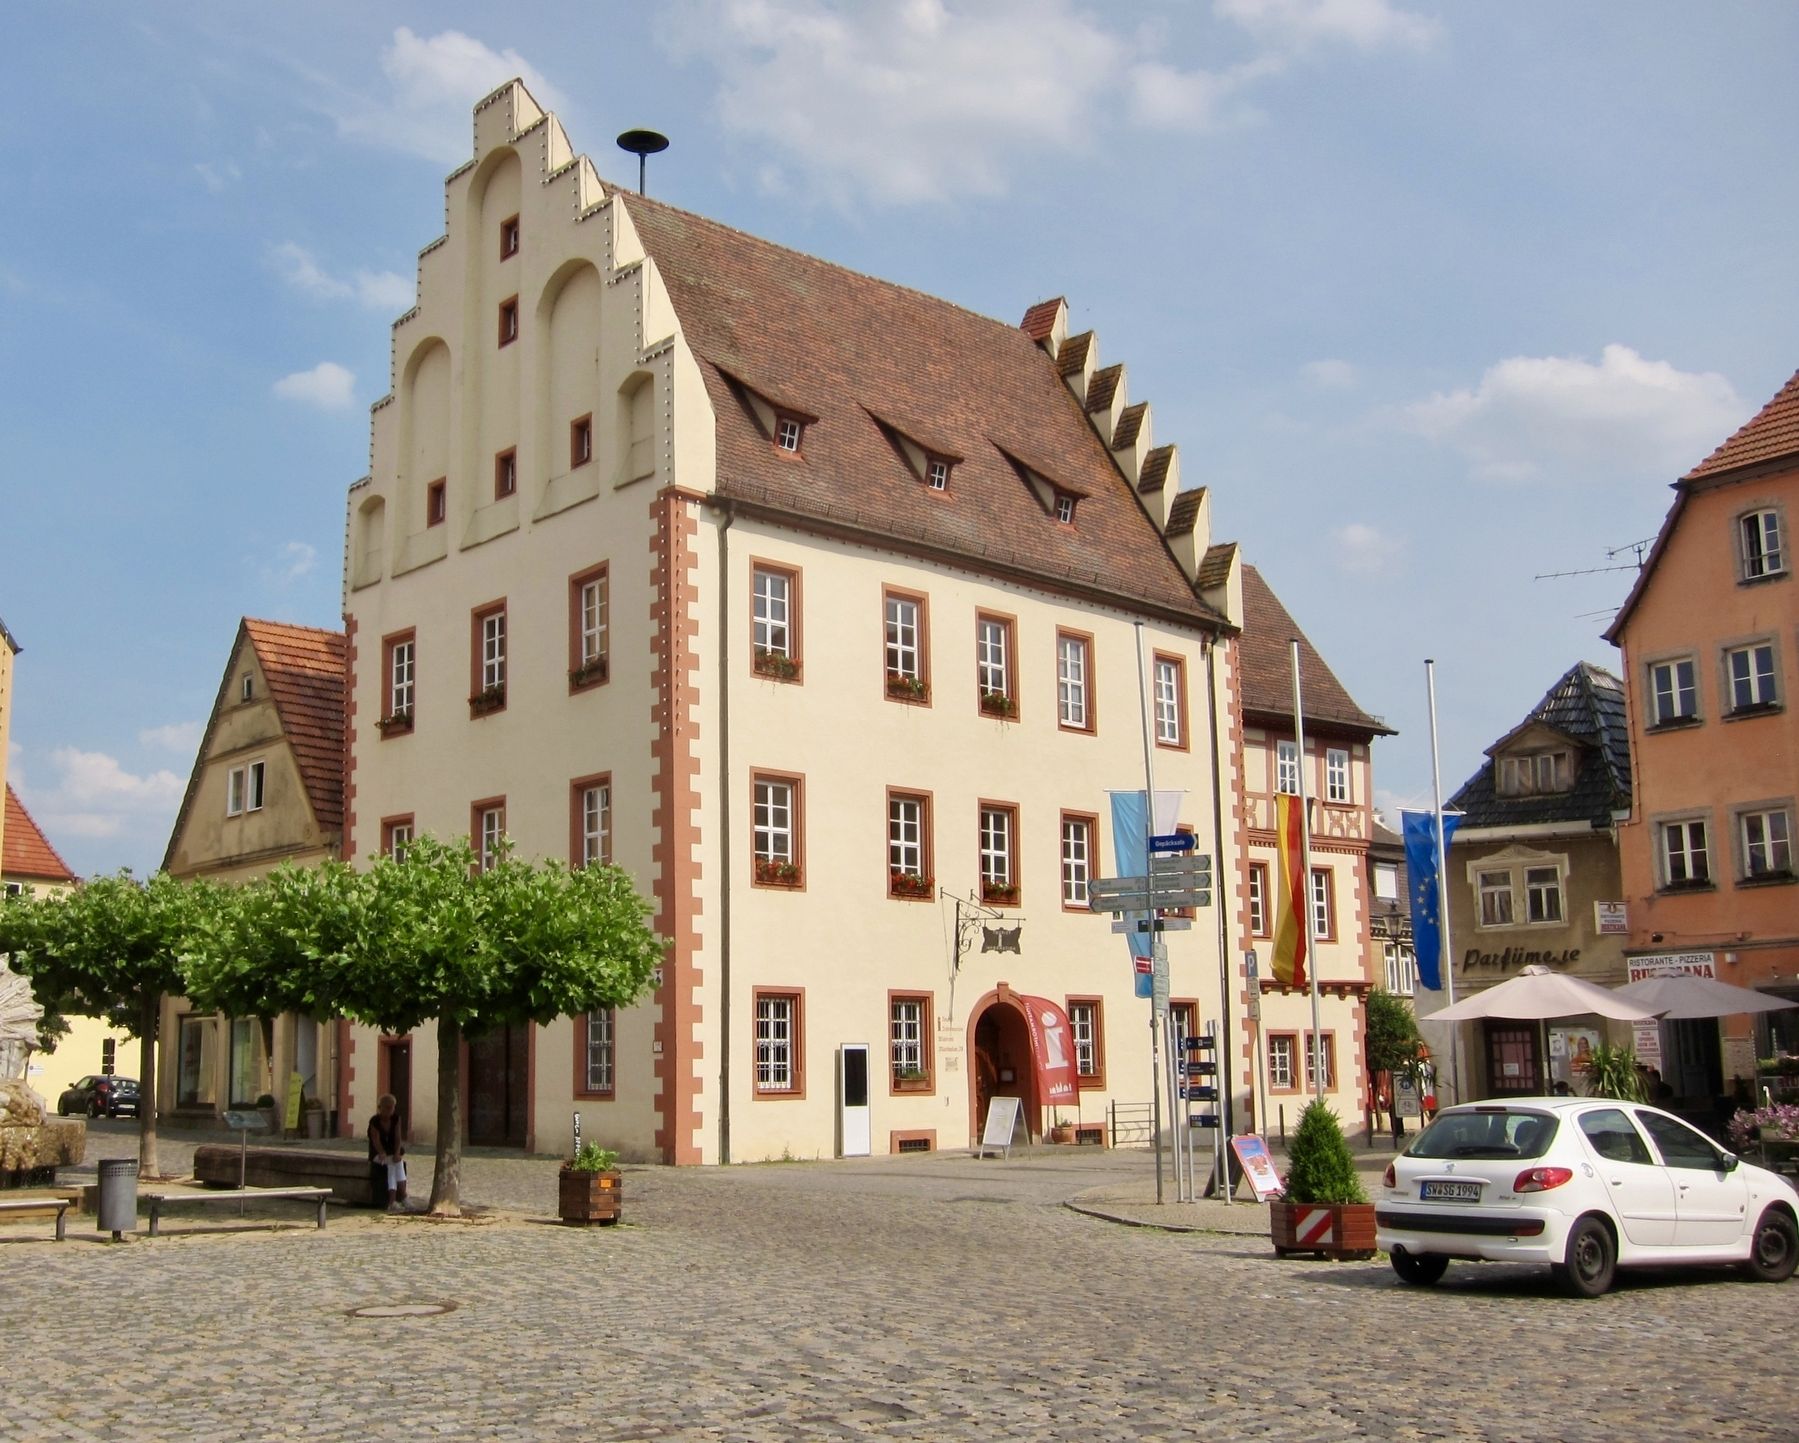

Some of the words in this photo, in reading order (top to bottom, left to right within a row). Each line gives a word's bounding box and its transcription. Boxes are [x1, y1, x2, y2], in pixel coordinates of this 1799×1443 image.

[1247, 954, 1255, 976] P
[1629, 956, 1673, 967] RISTORANTE
[1679, 954, 1713, 964] PIZZERIA
[1426, 1183, 1438, 1196] SW
[1443, 1184, 1455, 1197] SG
[1456, 1185, 1479, 1198] 1994
